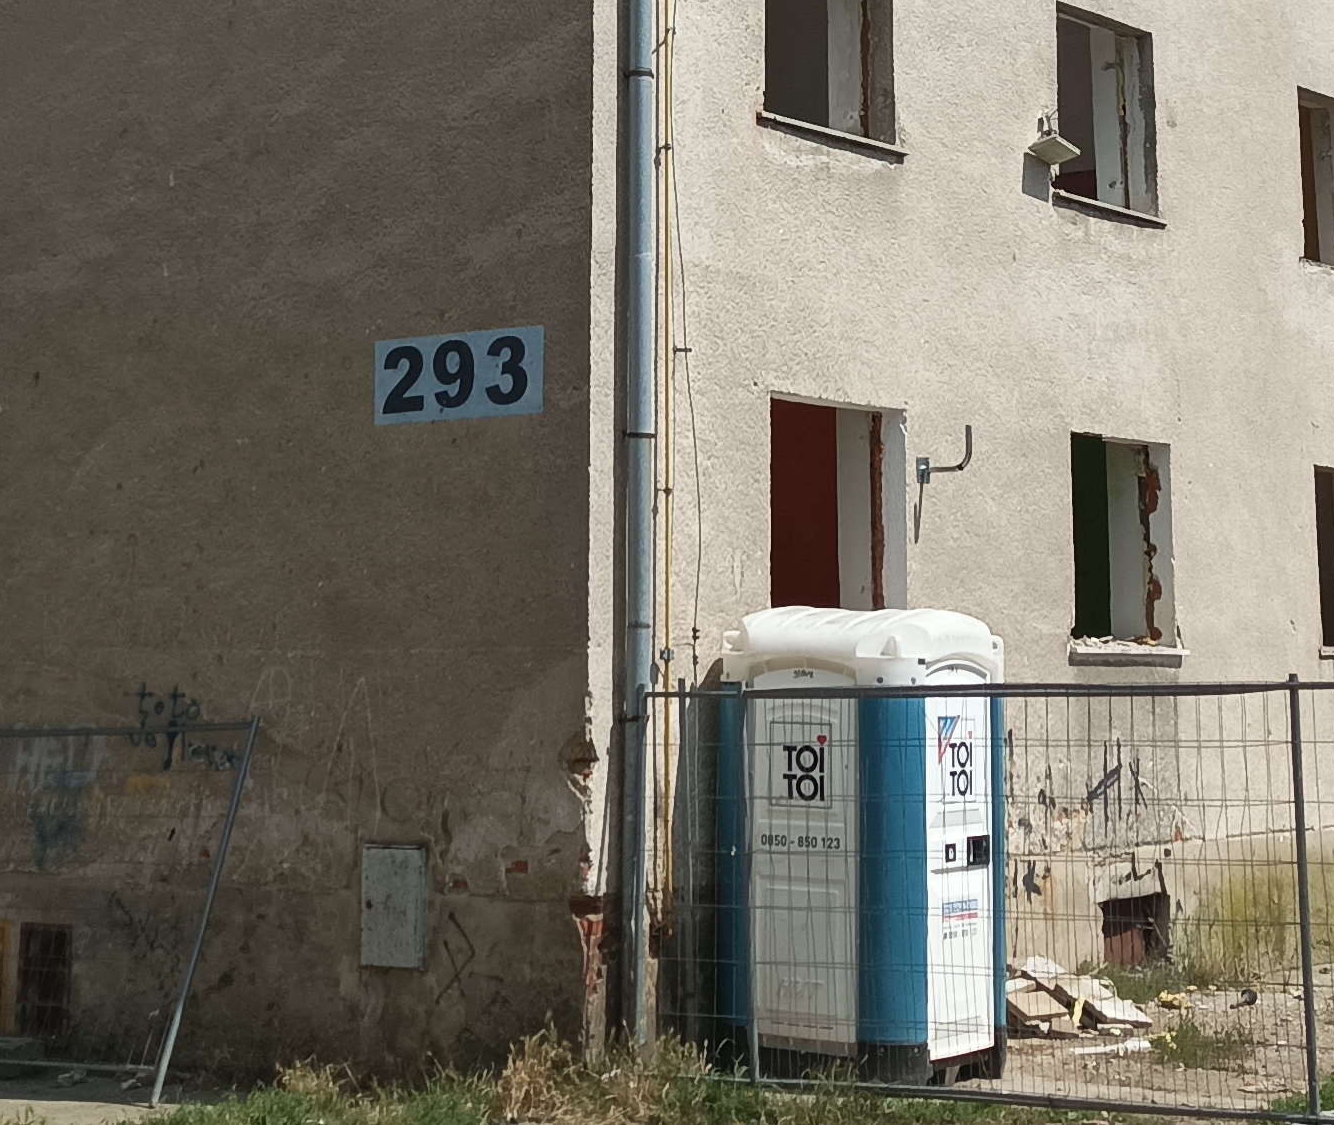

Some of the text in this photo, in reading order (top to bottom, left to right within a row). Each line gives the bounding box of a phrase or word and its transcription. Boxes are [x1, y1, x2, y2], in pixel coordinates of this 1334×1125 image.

[382, 335, 528, 415] 293
[782, 773, 825, 802] TOI
[949, 769, 973, 796] TOI
[760, 833, 788, 847] 0850
[820, 837, 841, 850] 123
